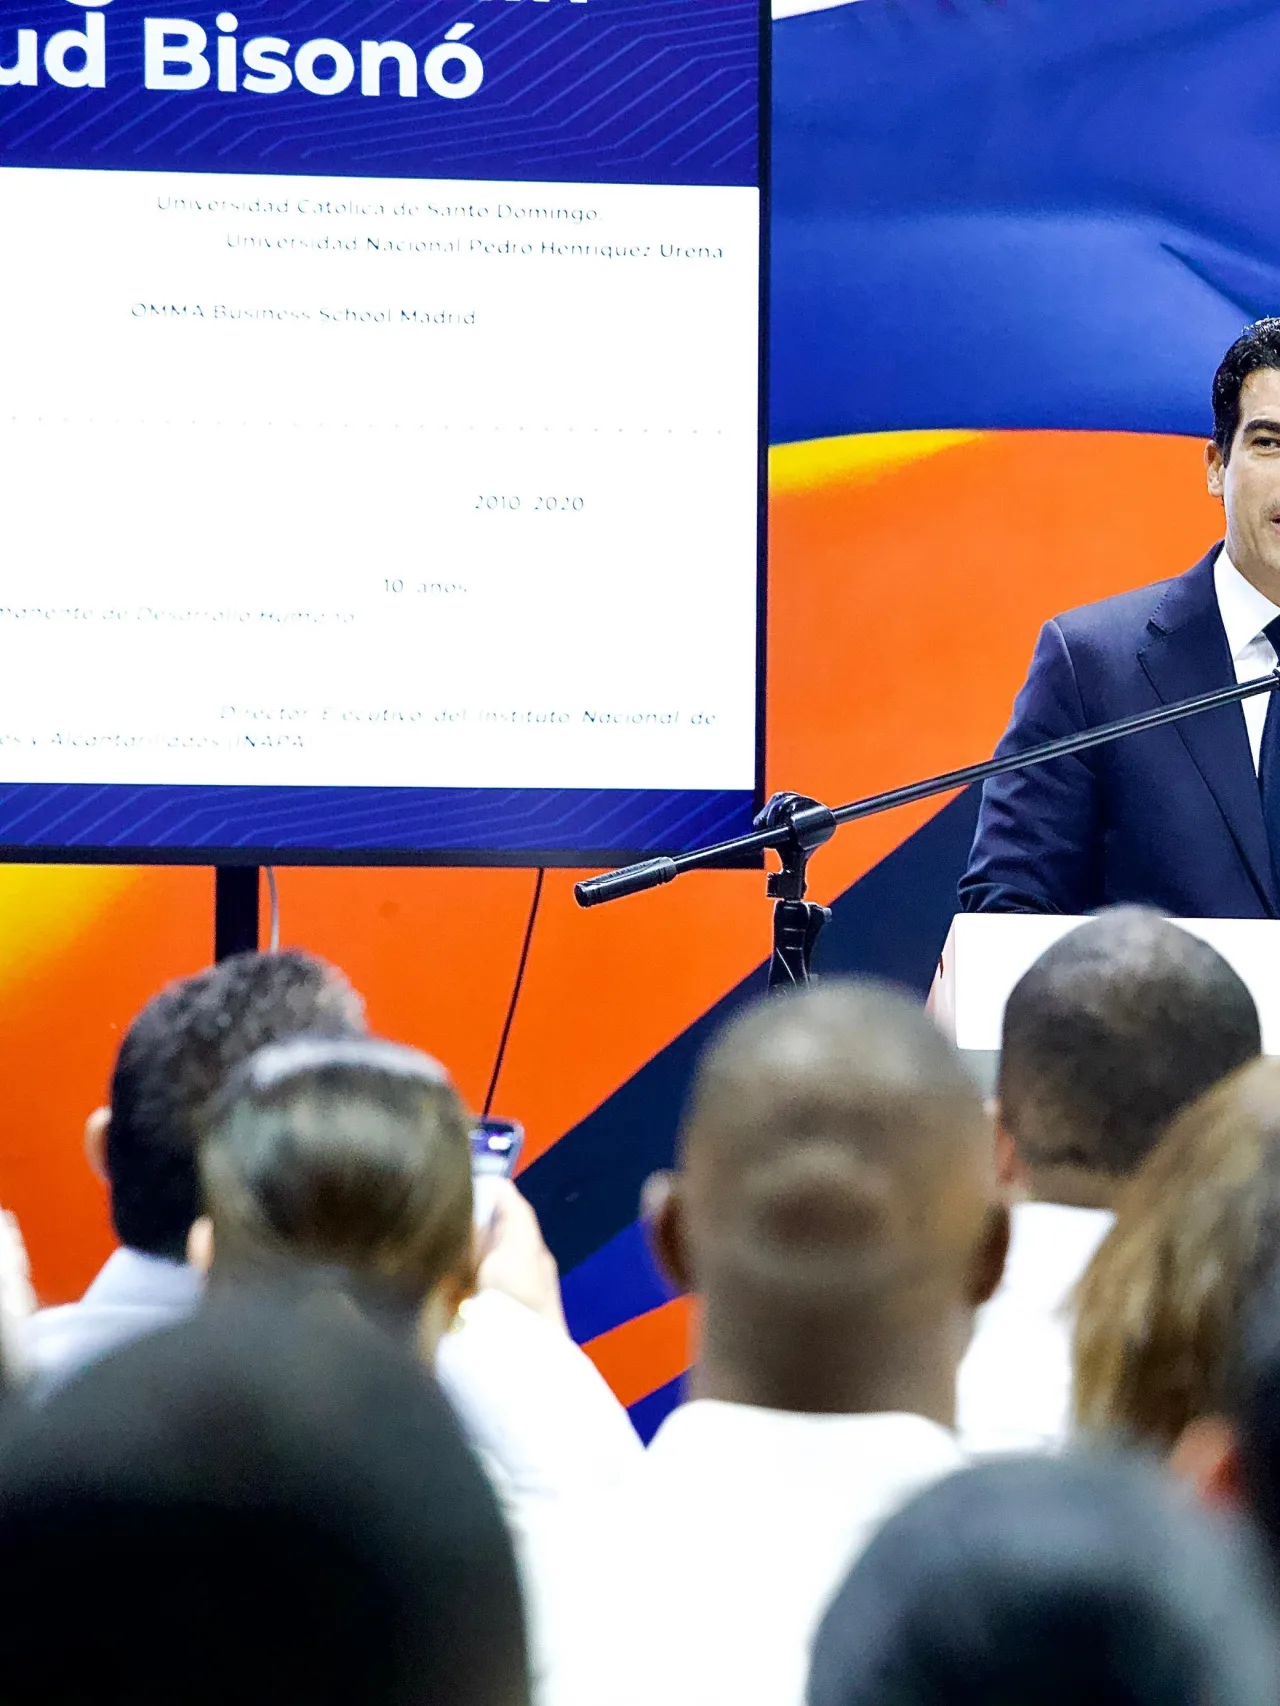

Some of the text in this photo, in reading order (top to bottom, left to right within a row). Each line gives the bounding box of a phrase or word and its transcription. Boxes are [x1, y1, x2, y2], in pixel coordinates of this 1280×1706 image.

[0, 11, 485, 99] ud Bisonó
[156, 194, 290, 215] Universidad
[392, 200, 420, 217] de
[427, 202, 489, 220] Santo
[225, 230, 358, 251] Universidad
[366, 235, 461, 254] Nacional
[469, 236, 534, 256] Pedro
[131, 301, 477, 326] OMMA Business School Madrid
[474, 492, 585, 512] 2010 2020
[384, 576, 404, 595] 10
[321, 705, 424, 727] Eecutivo
[477, 708, 571, 725] Instituto
[581, 708, 680, 727] Nacional
[688, 709, 718, 727] de
